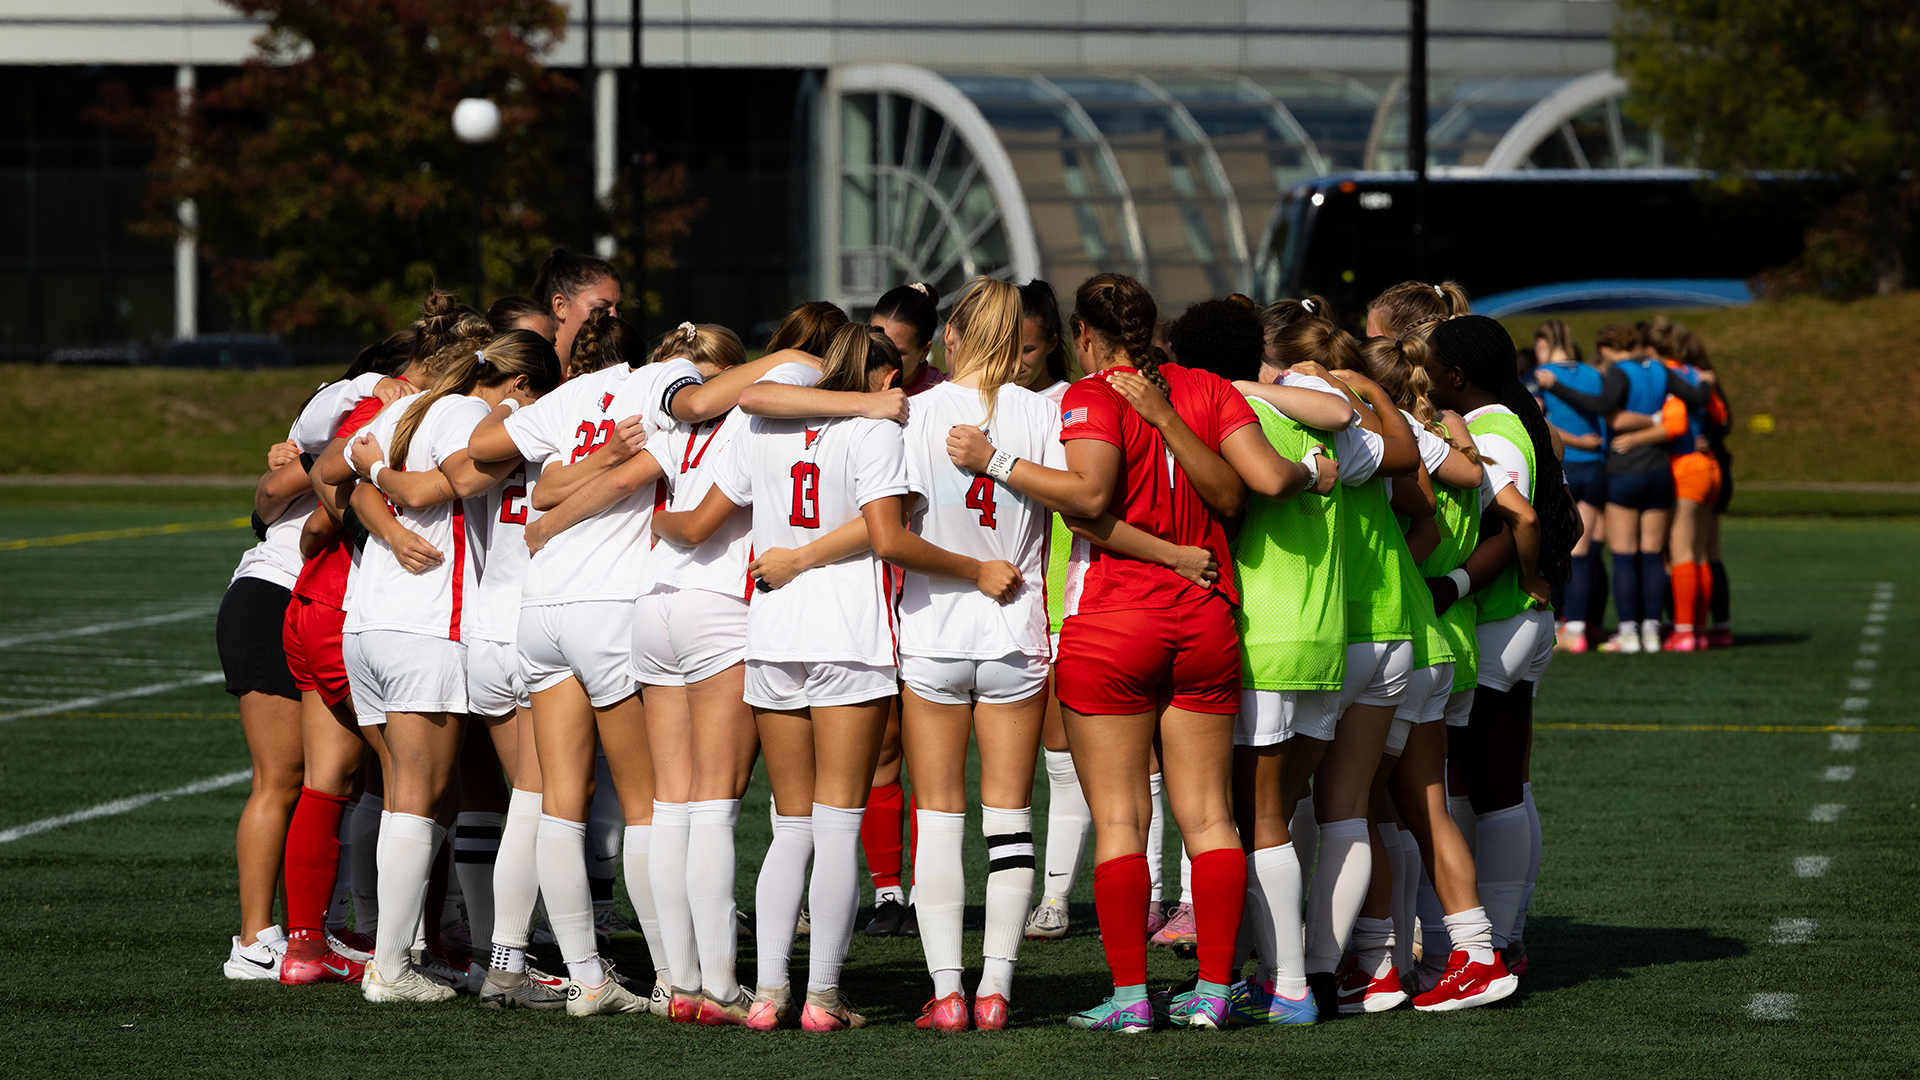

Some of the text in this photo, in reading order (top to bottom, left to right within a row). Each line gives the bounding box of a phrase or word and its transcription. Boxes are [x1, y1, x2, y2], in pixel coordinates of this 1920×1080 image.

[680, 409, 730, 474] 17
[789, 460, 821, 529] 13
[965, 472, 997, 530] 4
